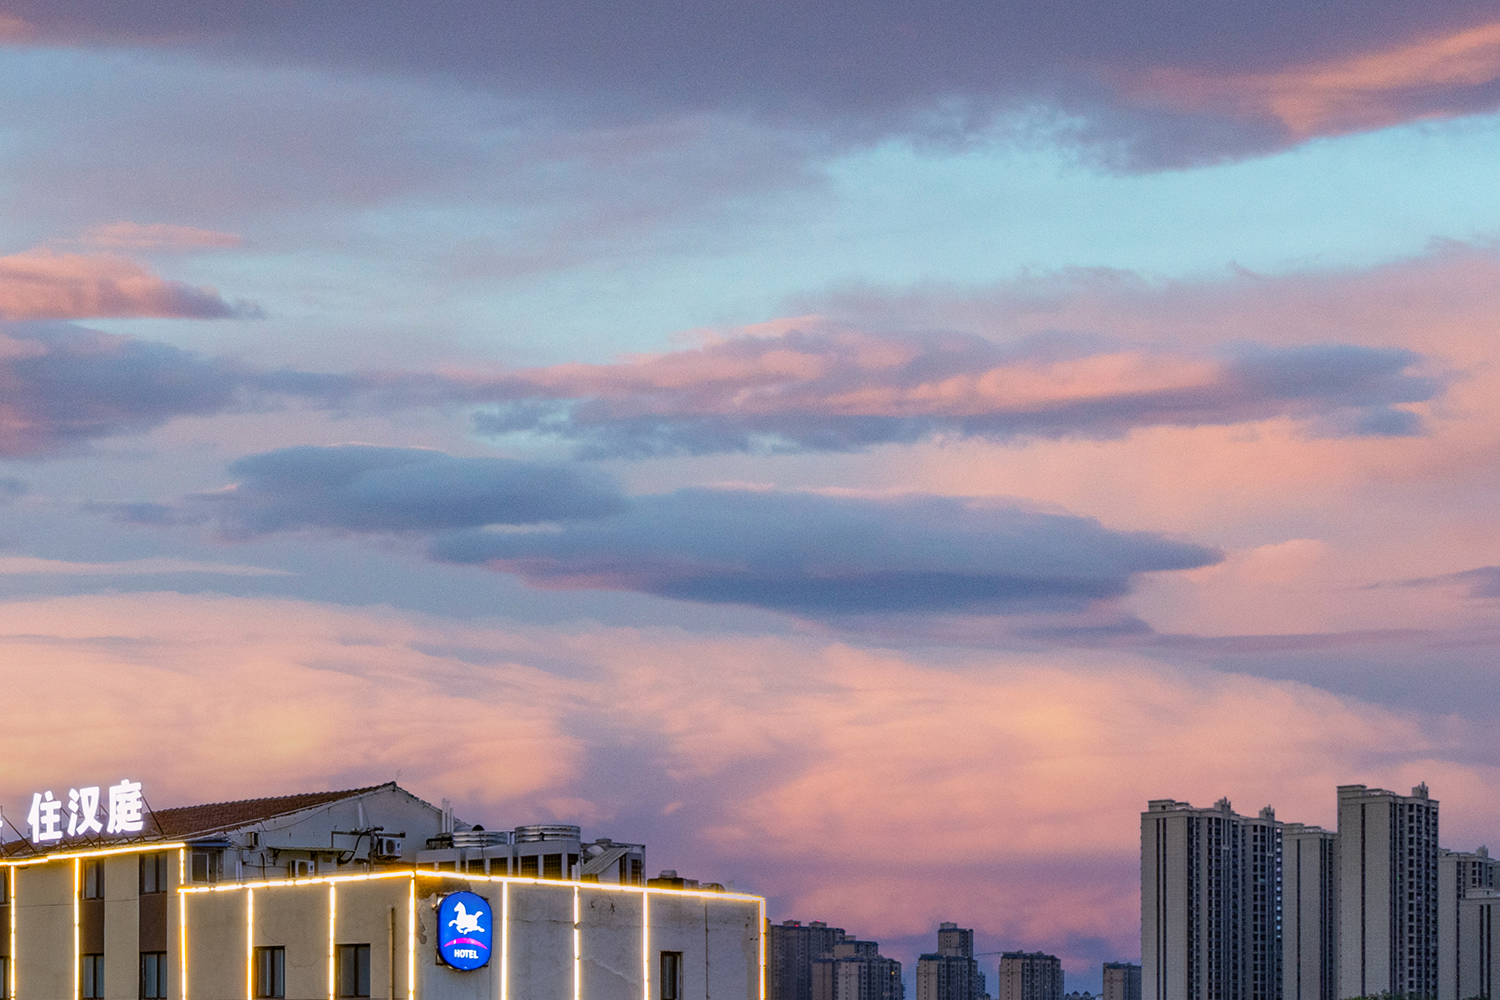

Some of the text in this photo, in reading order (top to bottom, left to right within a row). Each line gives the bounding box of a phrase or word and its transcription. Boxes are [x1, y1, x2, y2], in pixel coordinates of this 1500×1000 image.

[28, 779, 144, 844] 住汉庭
[453, 949, 479, 960] HOTEL
